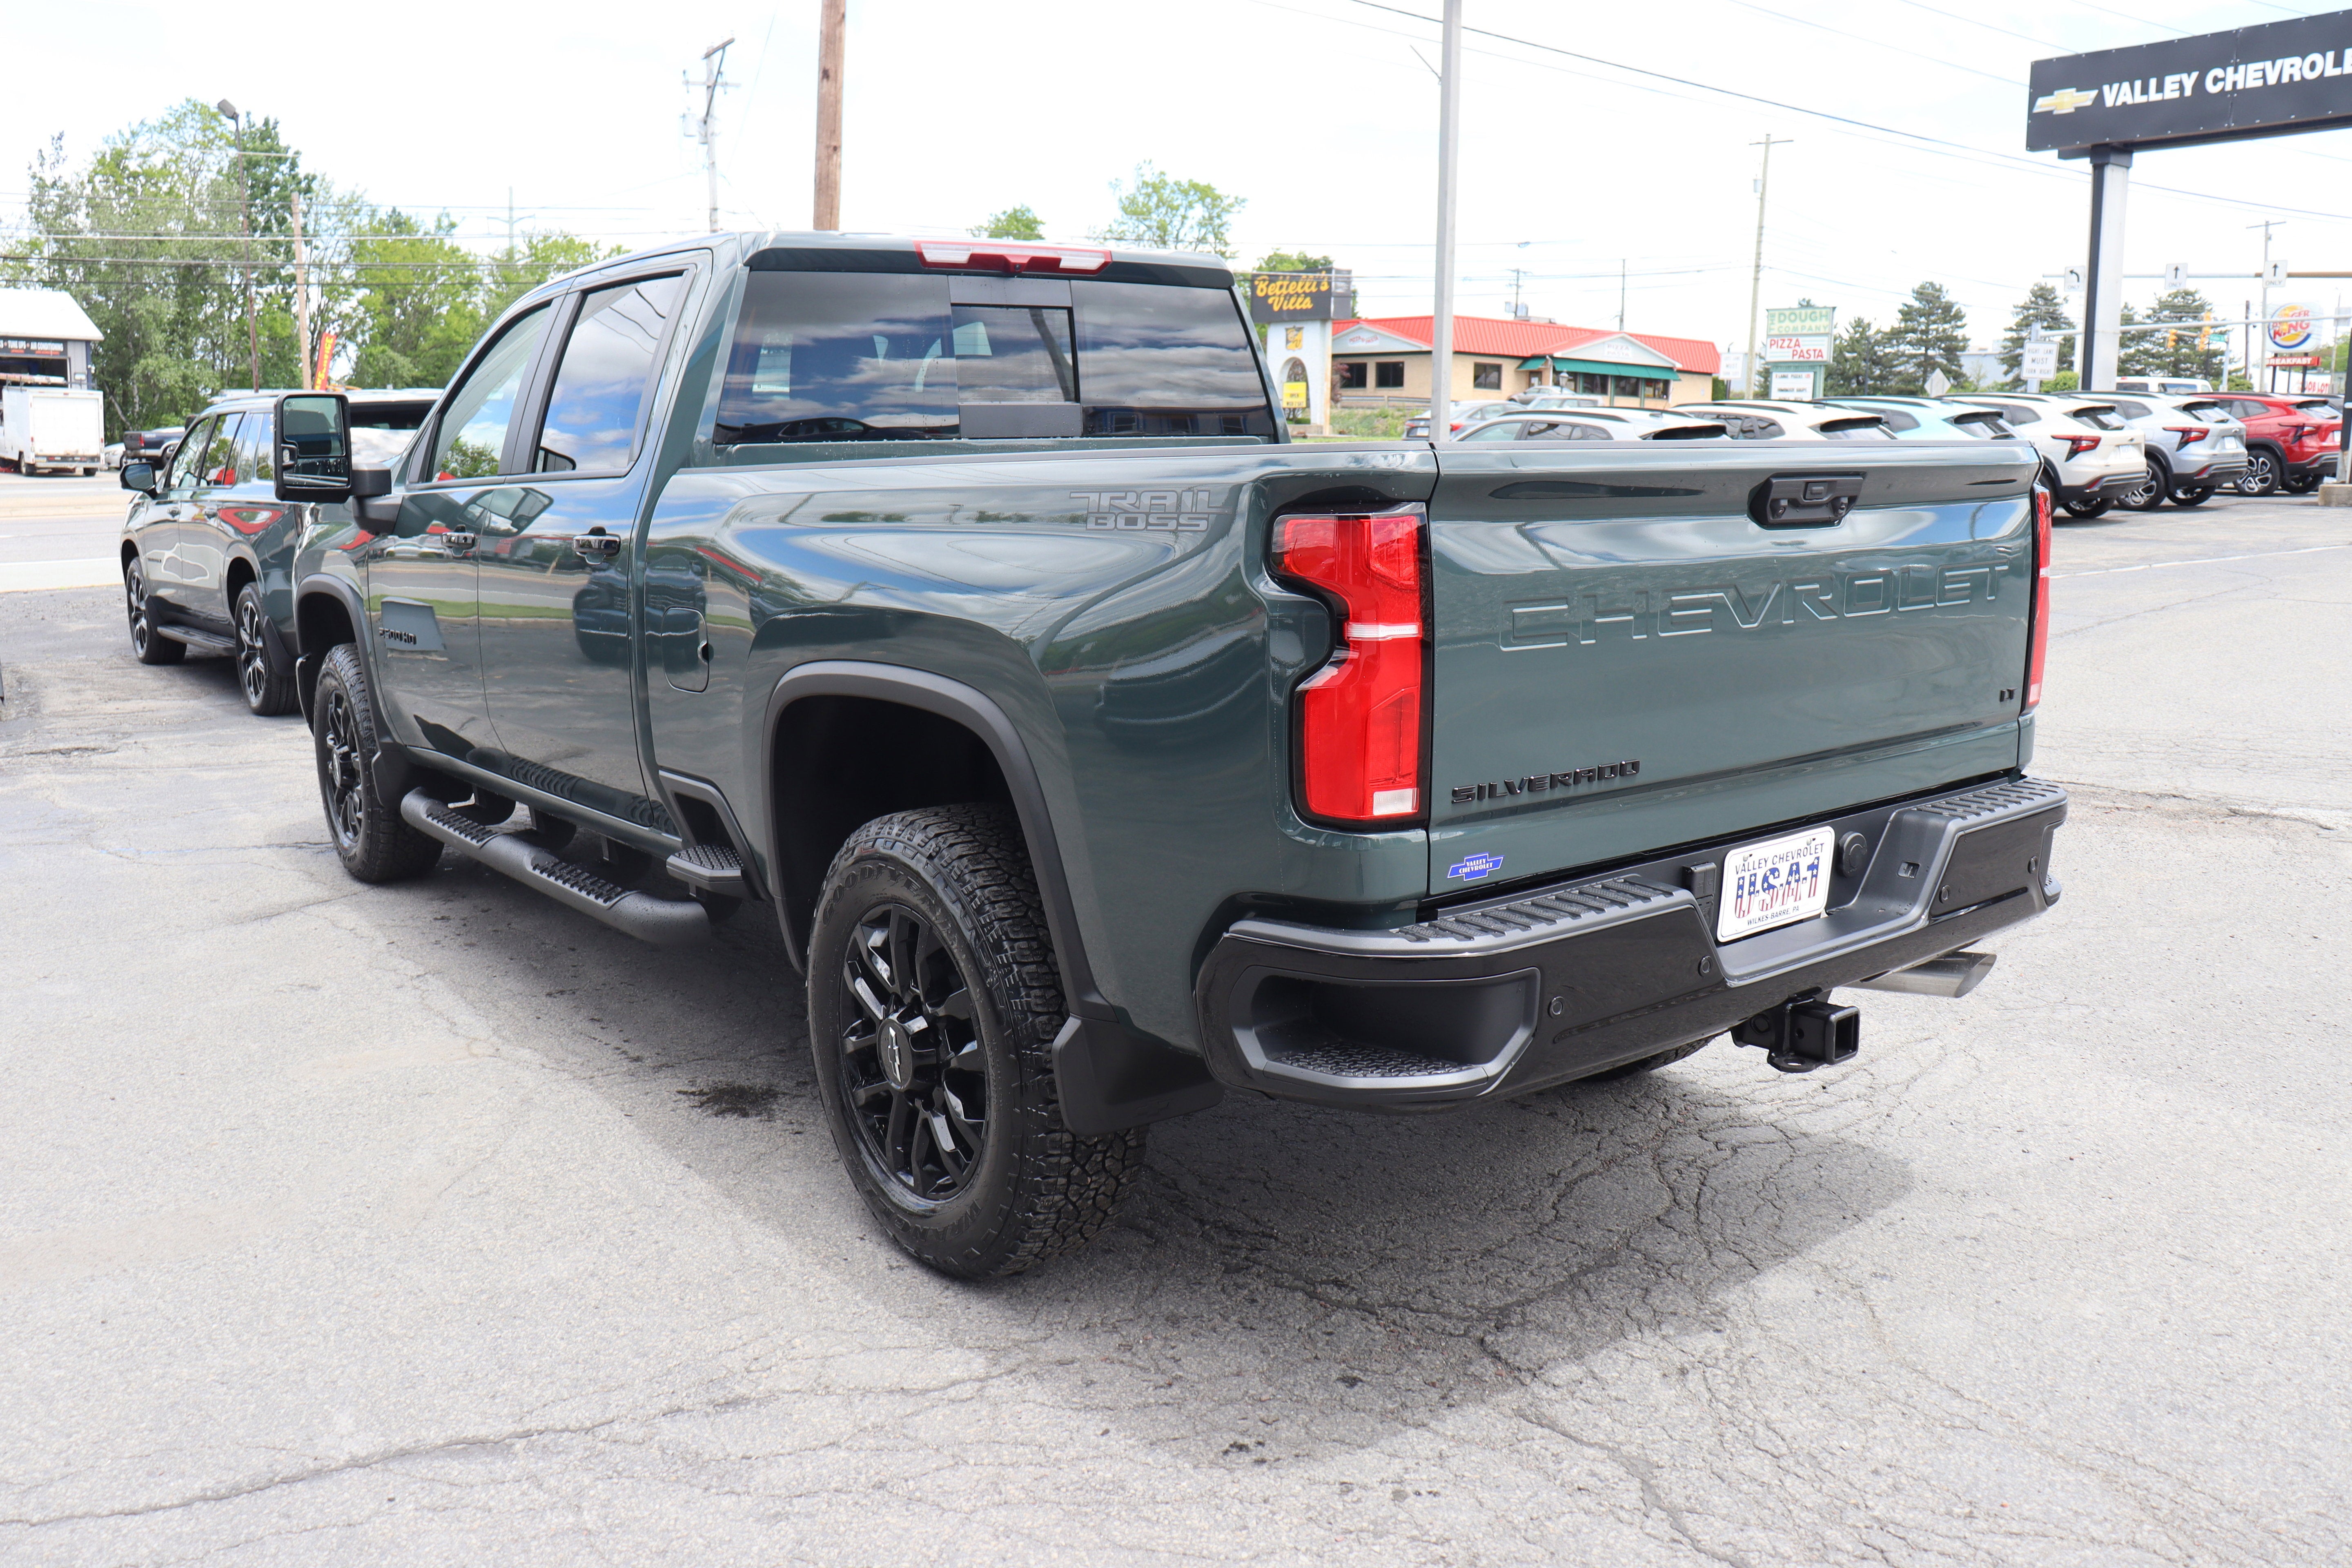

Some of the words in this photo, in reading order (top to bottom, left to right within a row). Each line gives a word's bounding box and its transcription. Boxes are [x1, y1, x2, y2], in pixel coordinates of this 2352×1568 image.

[2103, 71, 2199, 107] VALLEY
[1254, 271, 1330, 297] Bettelli's
[1267, 294, 1313, 312] Villa
[1778, 311, 1829, 323] DOUGH
[1770, 338, 1801, 348] PIZZA
[1792, 349, 1824, 359] PASTA
[1069, 490, 1232, 514] TRAIL
[1086, 511, 1209, 532] BOSS
[1499, 559, 2009, 651] CHEVROLET
[2000, 688, 2017, 702] LT
[1451, 759, 1640, 804] SILVERADO
[1466, 858, 1486, 867] VALLEY
[1735, 857, 1769, 875] VALLEY
[1772, 842, 1825, 865] CHEVROLET
[1459, 862, 1493, 874] CHEVROLET
[1747, 909, 1791, 926] WILKES-BARRE,
